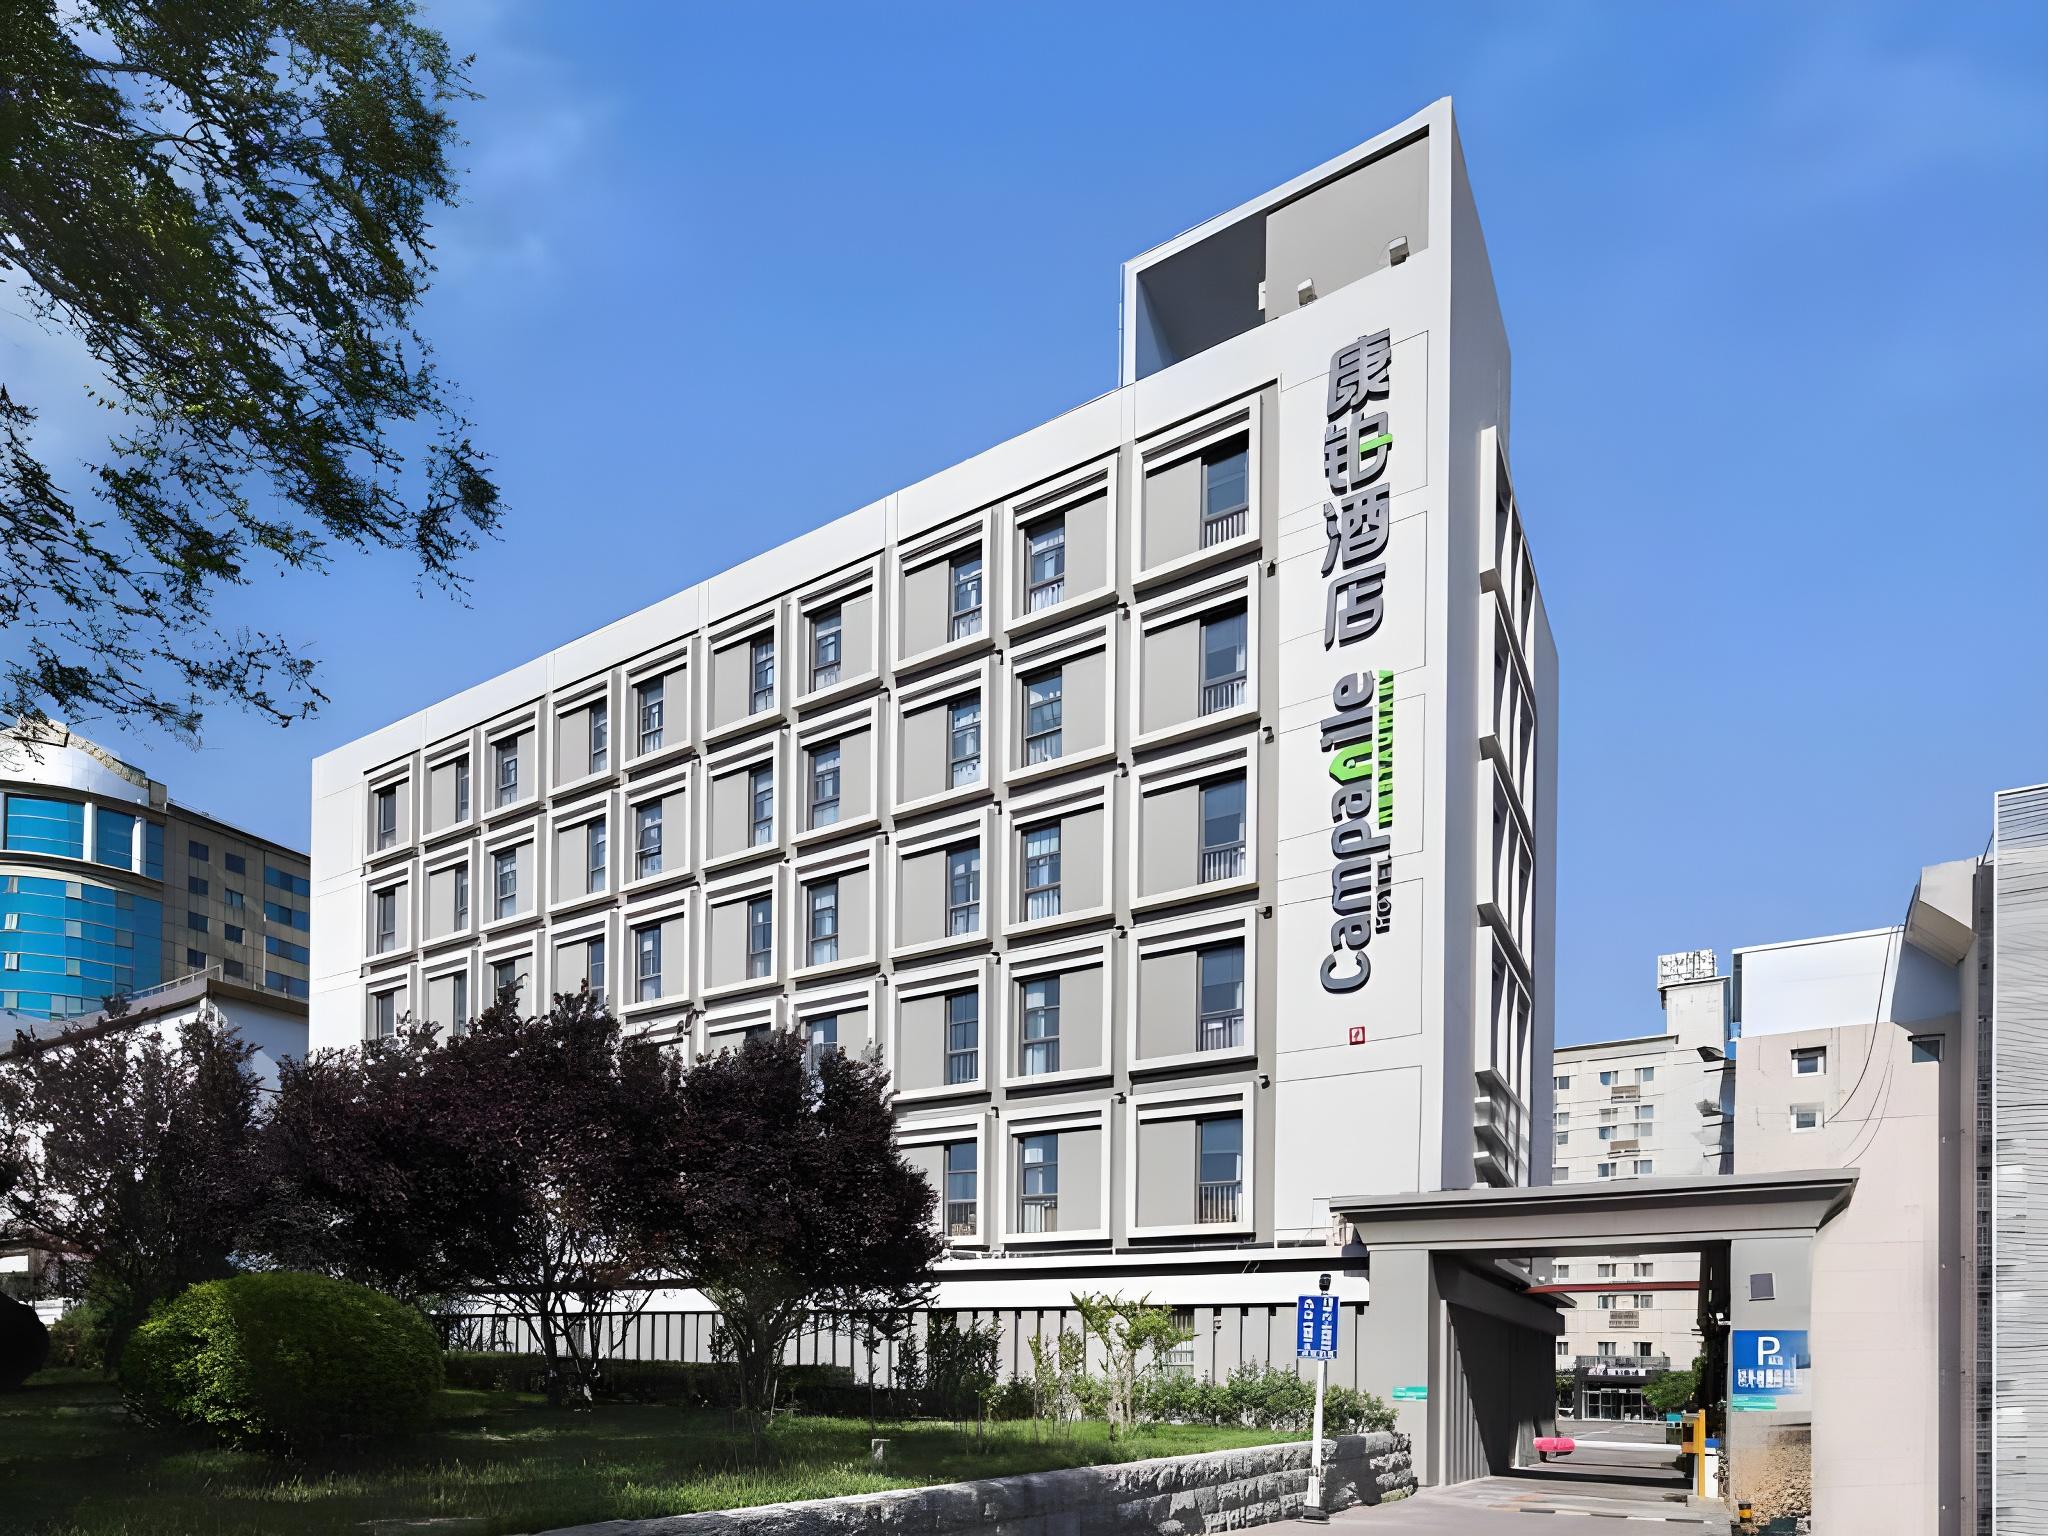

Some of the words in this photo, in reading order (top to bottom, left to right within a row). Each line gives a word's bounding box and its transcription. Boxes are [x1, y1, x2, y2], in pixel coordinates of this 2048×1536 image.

[1321, 328, 1393, 652] 康铂酒店
[1320, 670, 1391, 994] Campanile
[1757, 1336, 1780, 1366] P
